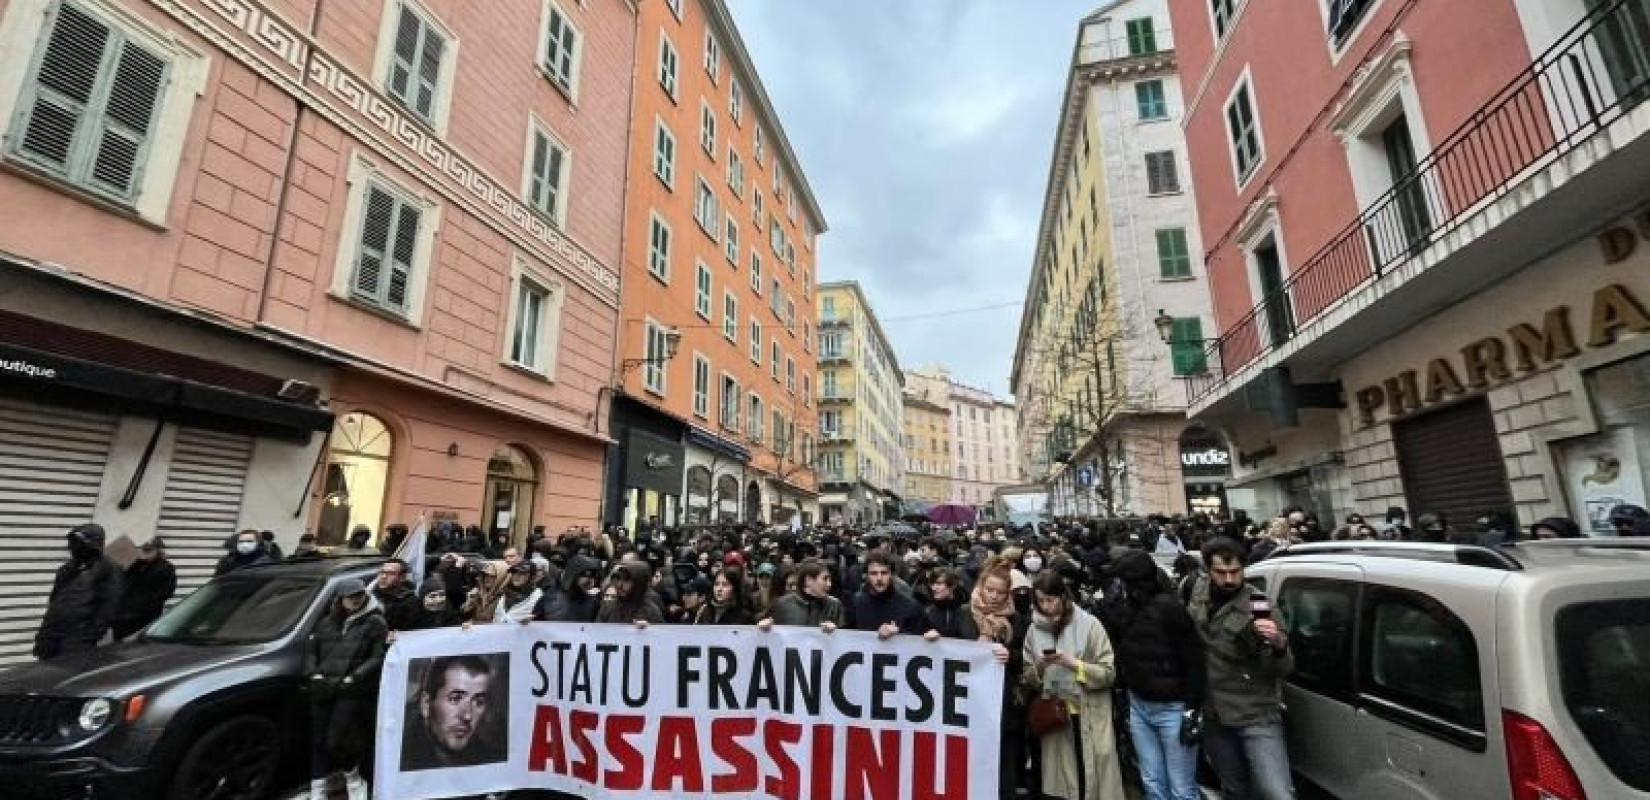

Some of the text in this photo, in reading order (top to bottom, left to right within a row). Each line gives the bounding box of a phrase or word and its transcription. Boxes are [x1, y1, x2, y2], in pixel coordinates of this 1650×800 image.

[0, 359, 56, 379] utique
[1355, 284, 1650, 424] PHARMA
[530, 641, 971, 728] STATU FRANCESE
[528, 704, 969, 800] ASSASSINU
